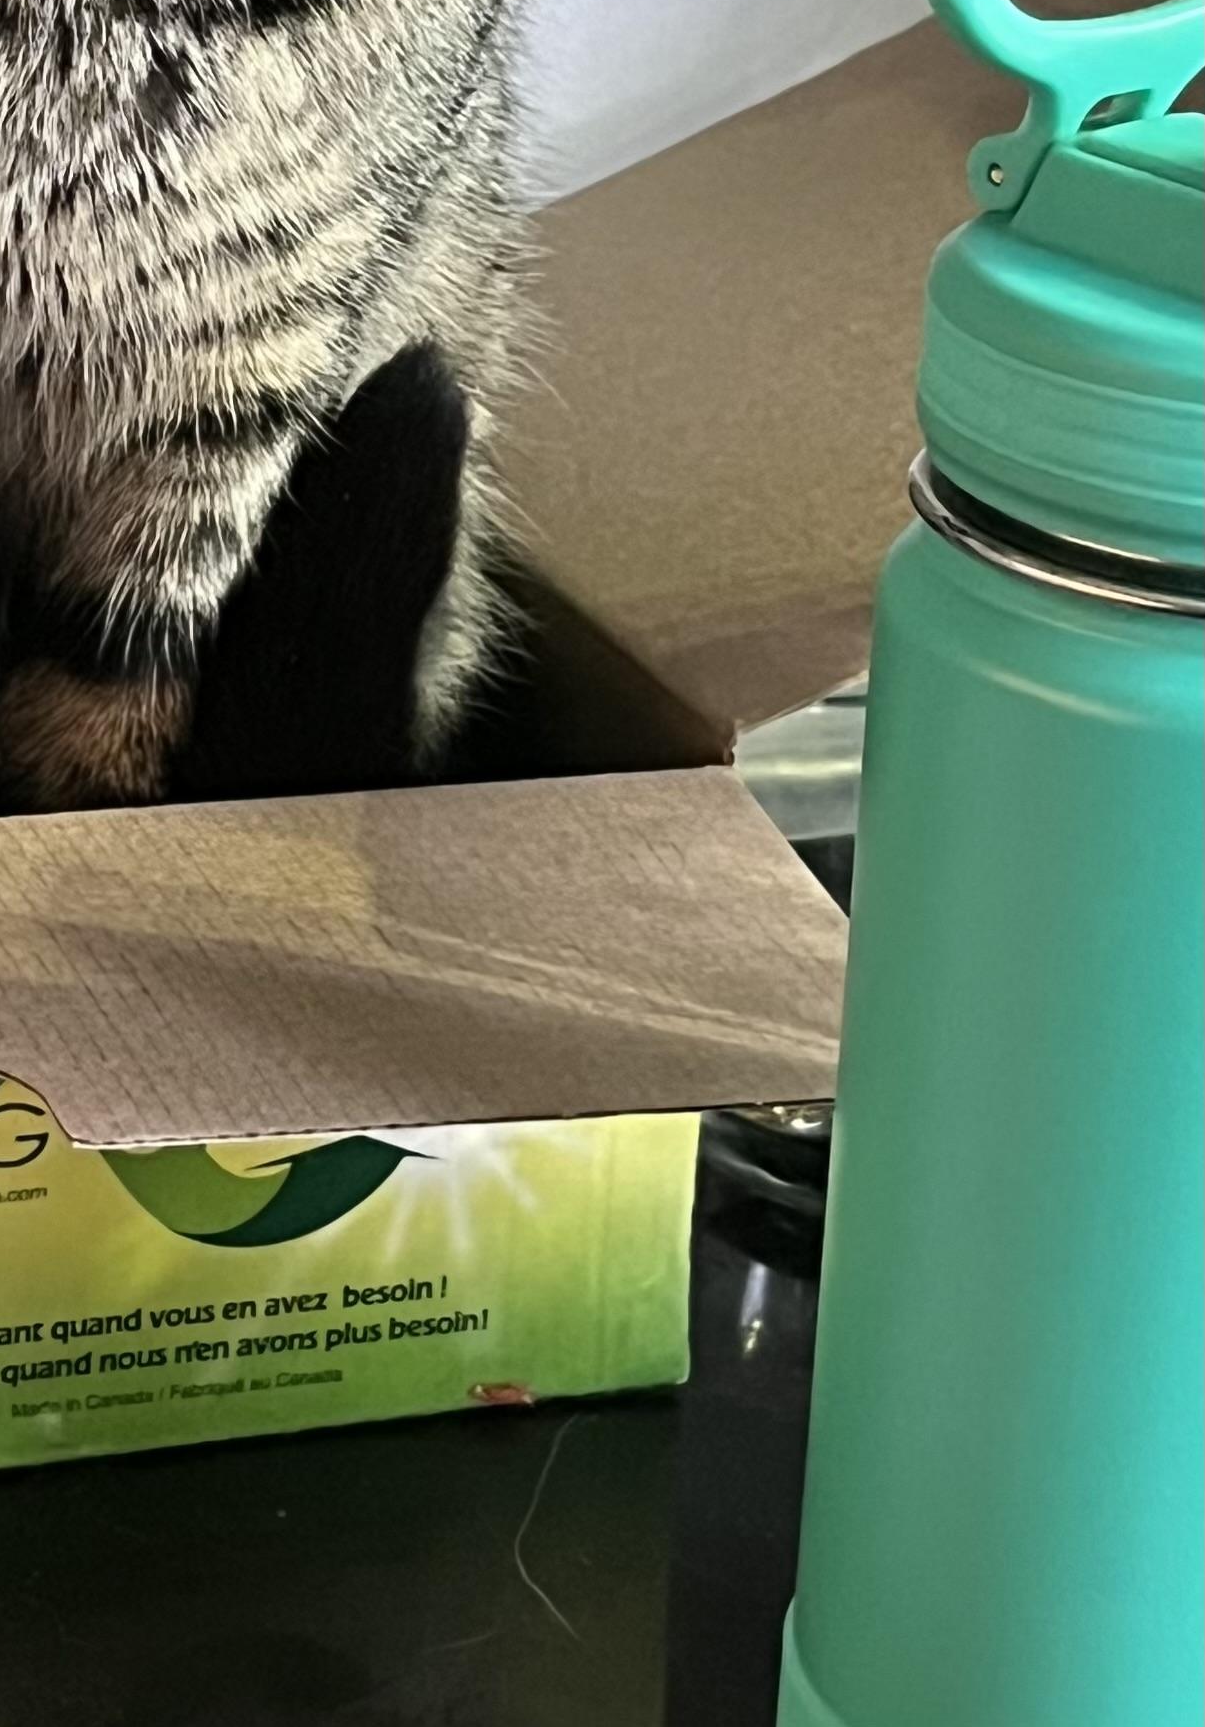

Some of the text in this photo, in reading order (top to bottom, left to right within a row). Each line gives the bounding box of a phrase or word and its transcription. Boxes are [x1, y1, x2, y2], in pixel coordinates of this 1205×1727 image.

[51, 1308, 141, 1344] quand
[150, 1305, 214, 1328] vous
[222, 1300, 256, 1320] en
[264, 1292, 327, 1316] avez
[0, 1351, 93, 1387] quand
[99, 1347, 167, 1373] nous
[175, 1340, 229, 1363] n'en
[236, 1330, 318, 1356] avons
[325, 1323, 382, 1351] plus
